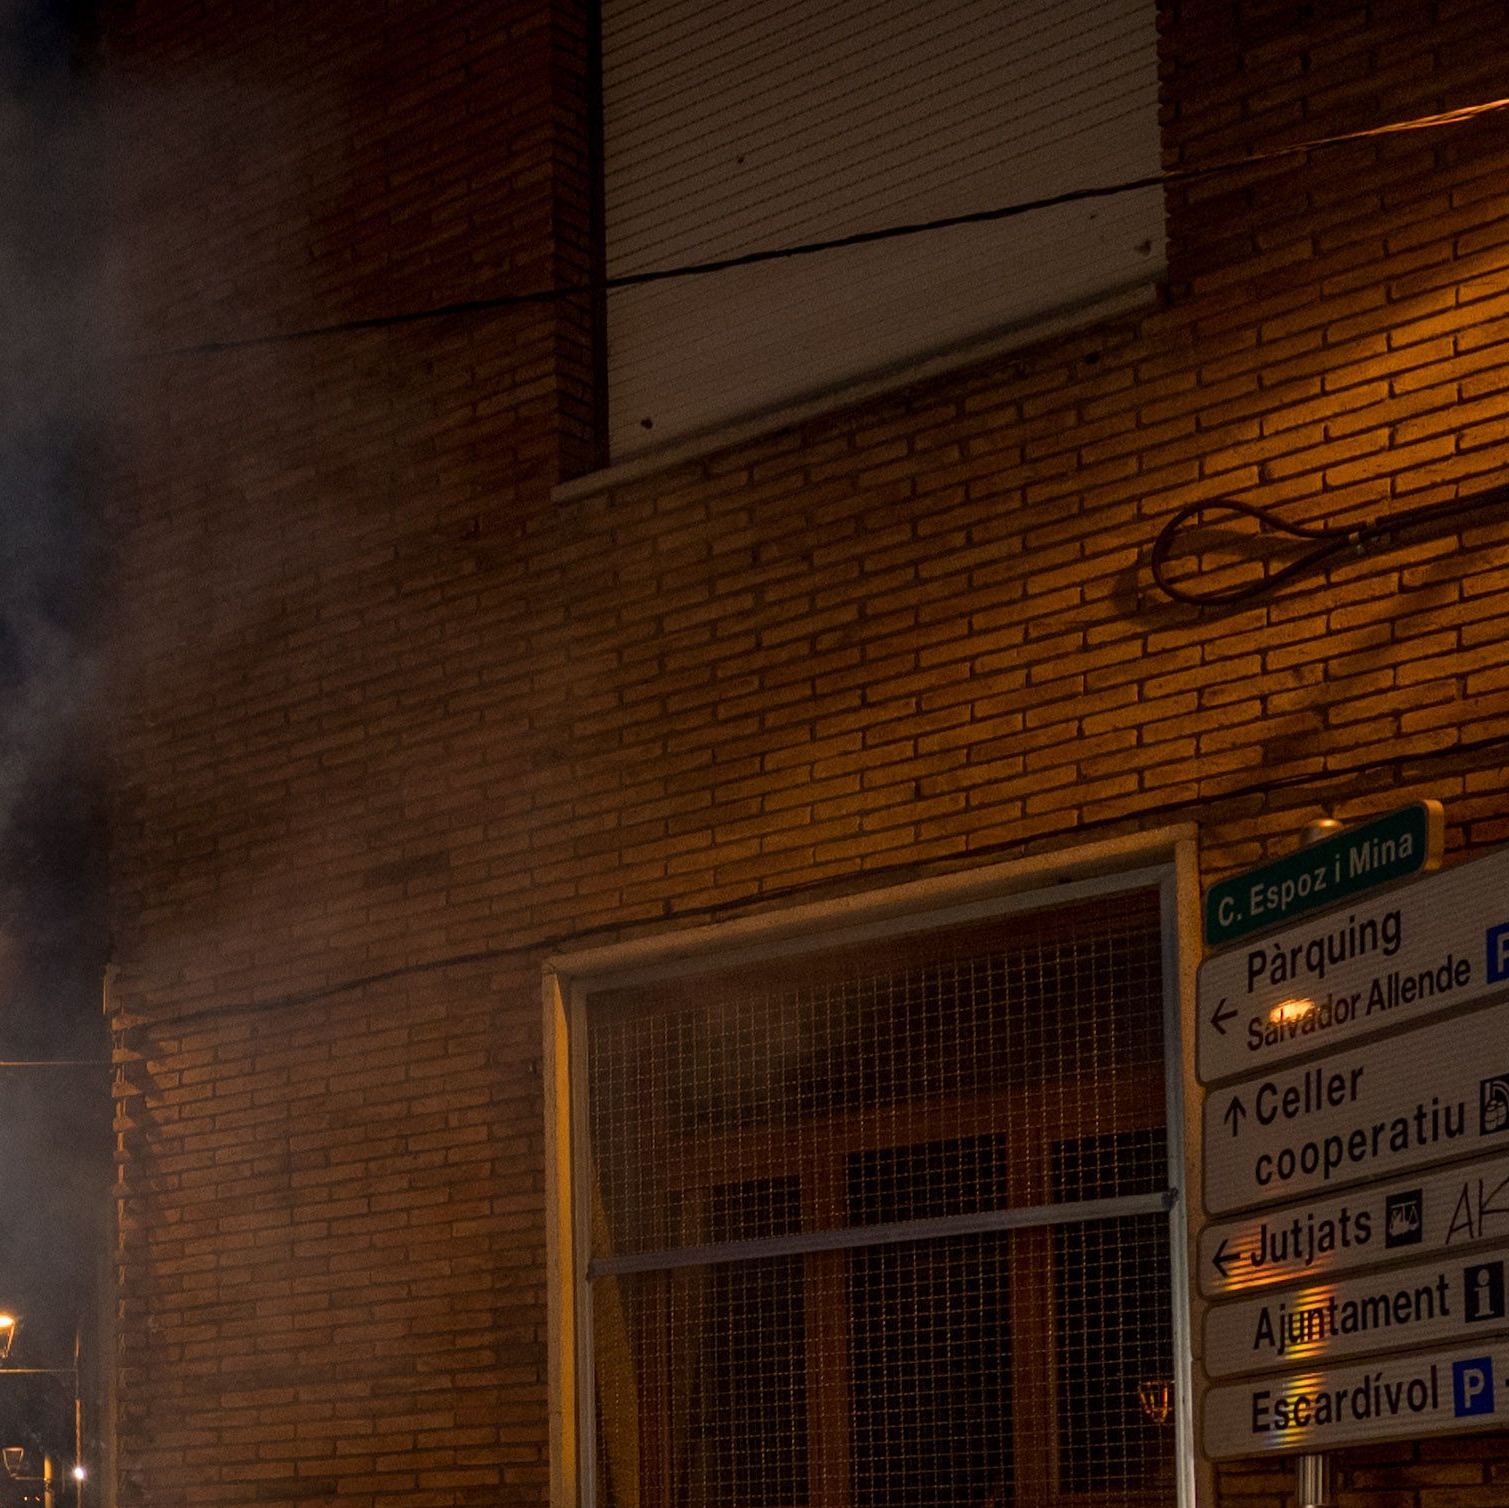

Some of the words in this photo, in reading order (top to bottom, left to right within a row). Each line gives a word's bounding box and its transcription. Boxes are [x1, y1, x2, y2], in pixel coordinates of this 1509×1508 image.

[1216, 896, 1243, 928] C.
[1249, 866, 1328, 917] Espoz
[1334, 853, 1341, 883] i
[1348, 831, 1414, 879] Mina
[1247, 910, 1402, 993] Pàrquing
[1247, 993, 1362, 1051] Salvador
[1365, 954, 1471, 1016] Allende
[1256, 1067, 1364, 1125] Celler
[1255, 1097, 1465, 1186] cooperatiu
[1250, 1207, 1372, 1267] Jutjats
[1253, 1274, 1450, 1356] Ajuntament
[1251, 1364, 1439, 1434] Escardívol
